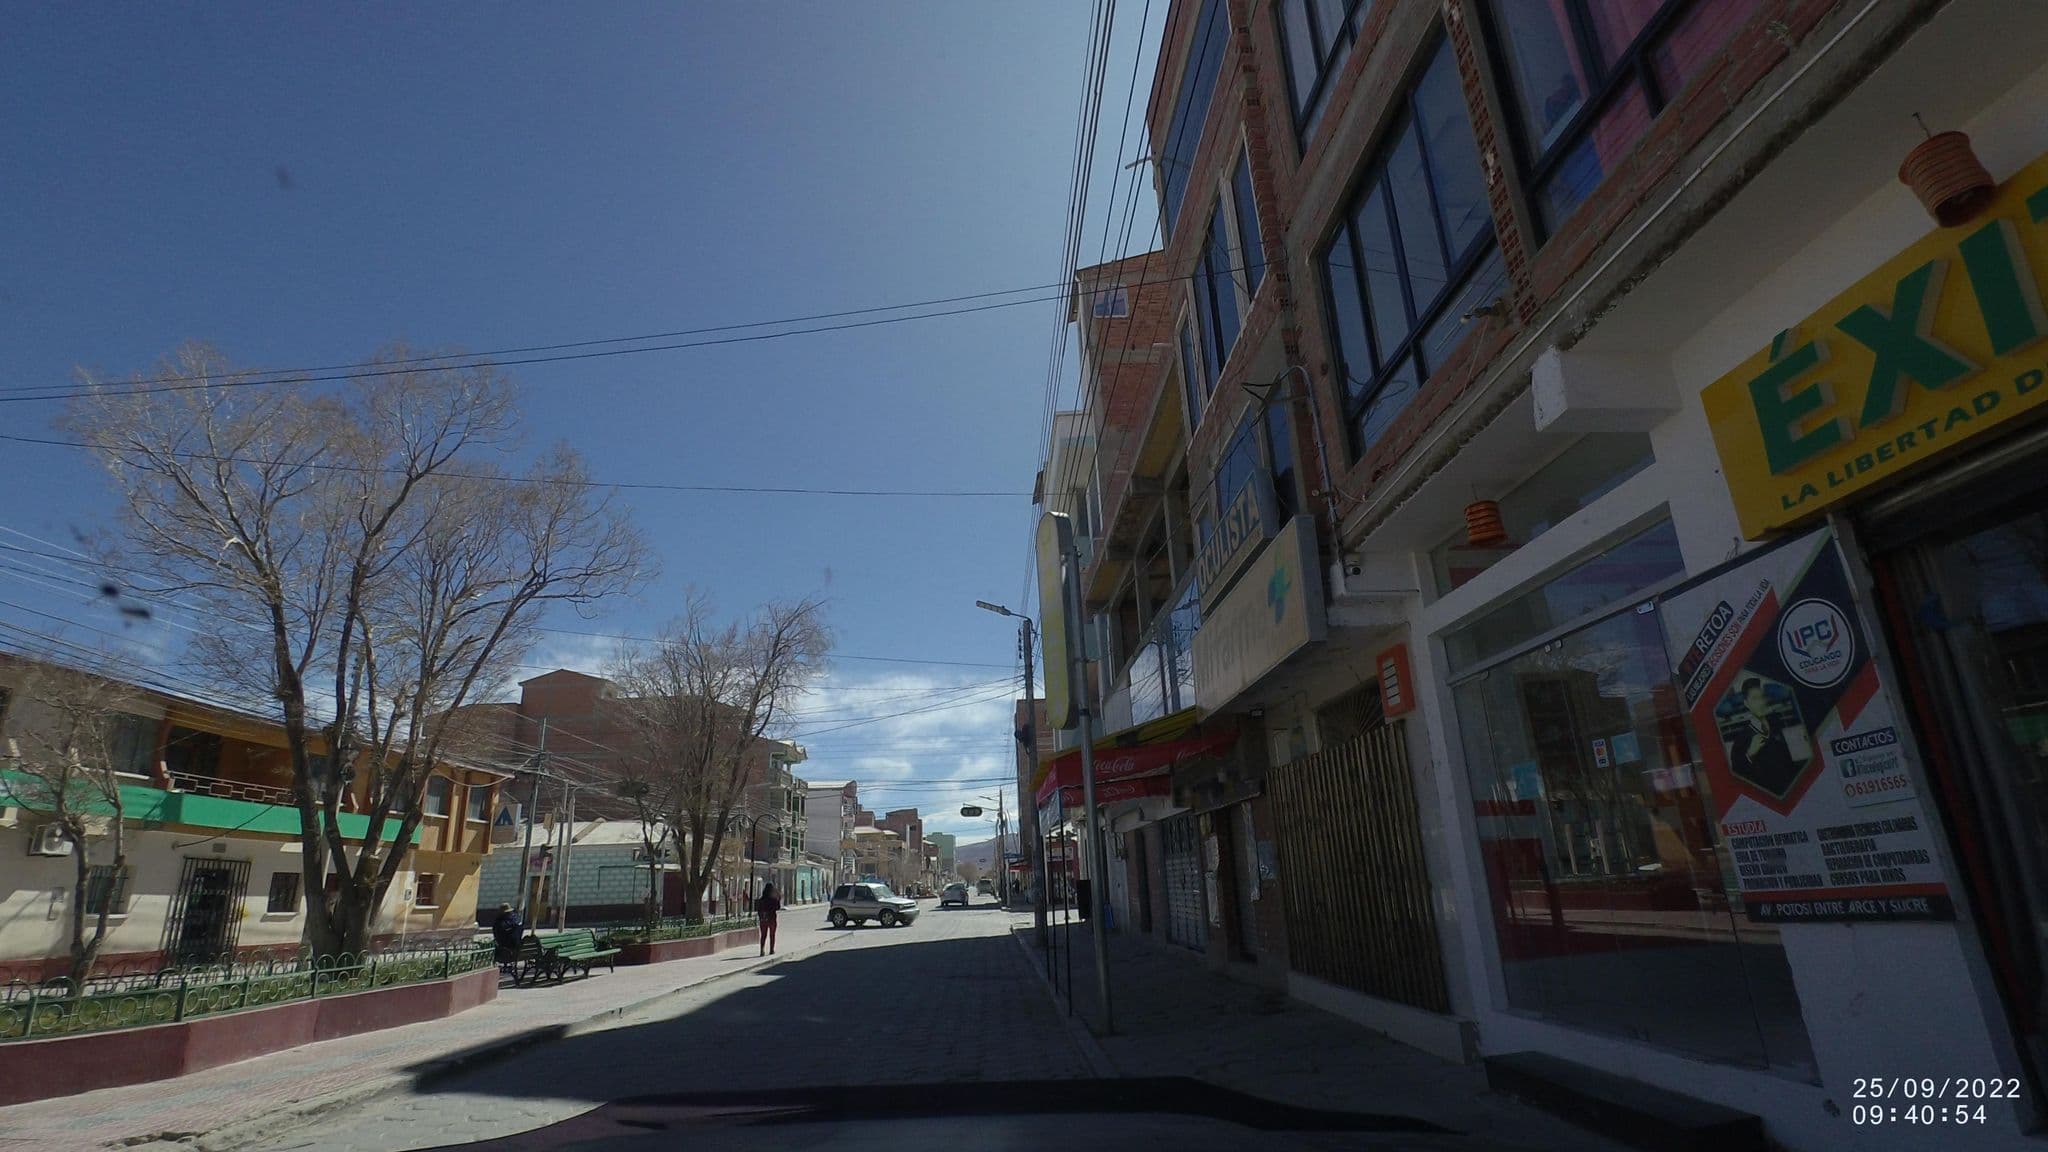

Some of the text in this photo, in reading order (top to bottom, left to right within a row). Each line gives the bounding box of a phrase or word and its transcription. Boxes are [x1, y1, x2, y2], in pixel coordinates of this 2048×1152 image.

[1748, 185, 2048, 476] ÉXI
[1781, 363, 2048, 510] LA LIBERTAD D
[1198, 482, 1260, 593] OCULISTA
[1835, 731, 1894, 754] CONTACTOS
[1776, 902, 1812, 917] POTOSI
[1814, 901, 1845, 915] ENTRE
[1848, 900, 1877, 914] ARCE
[1877, 900, 1886, 913] Y
[1890, 897, 1929, 913] SUCRE
